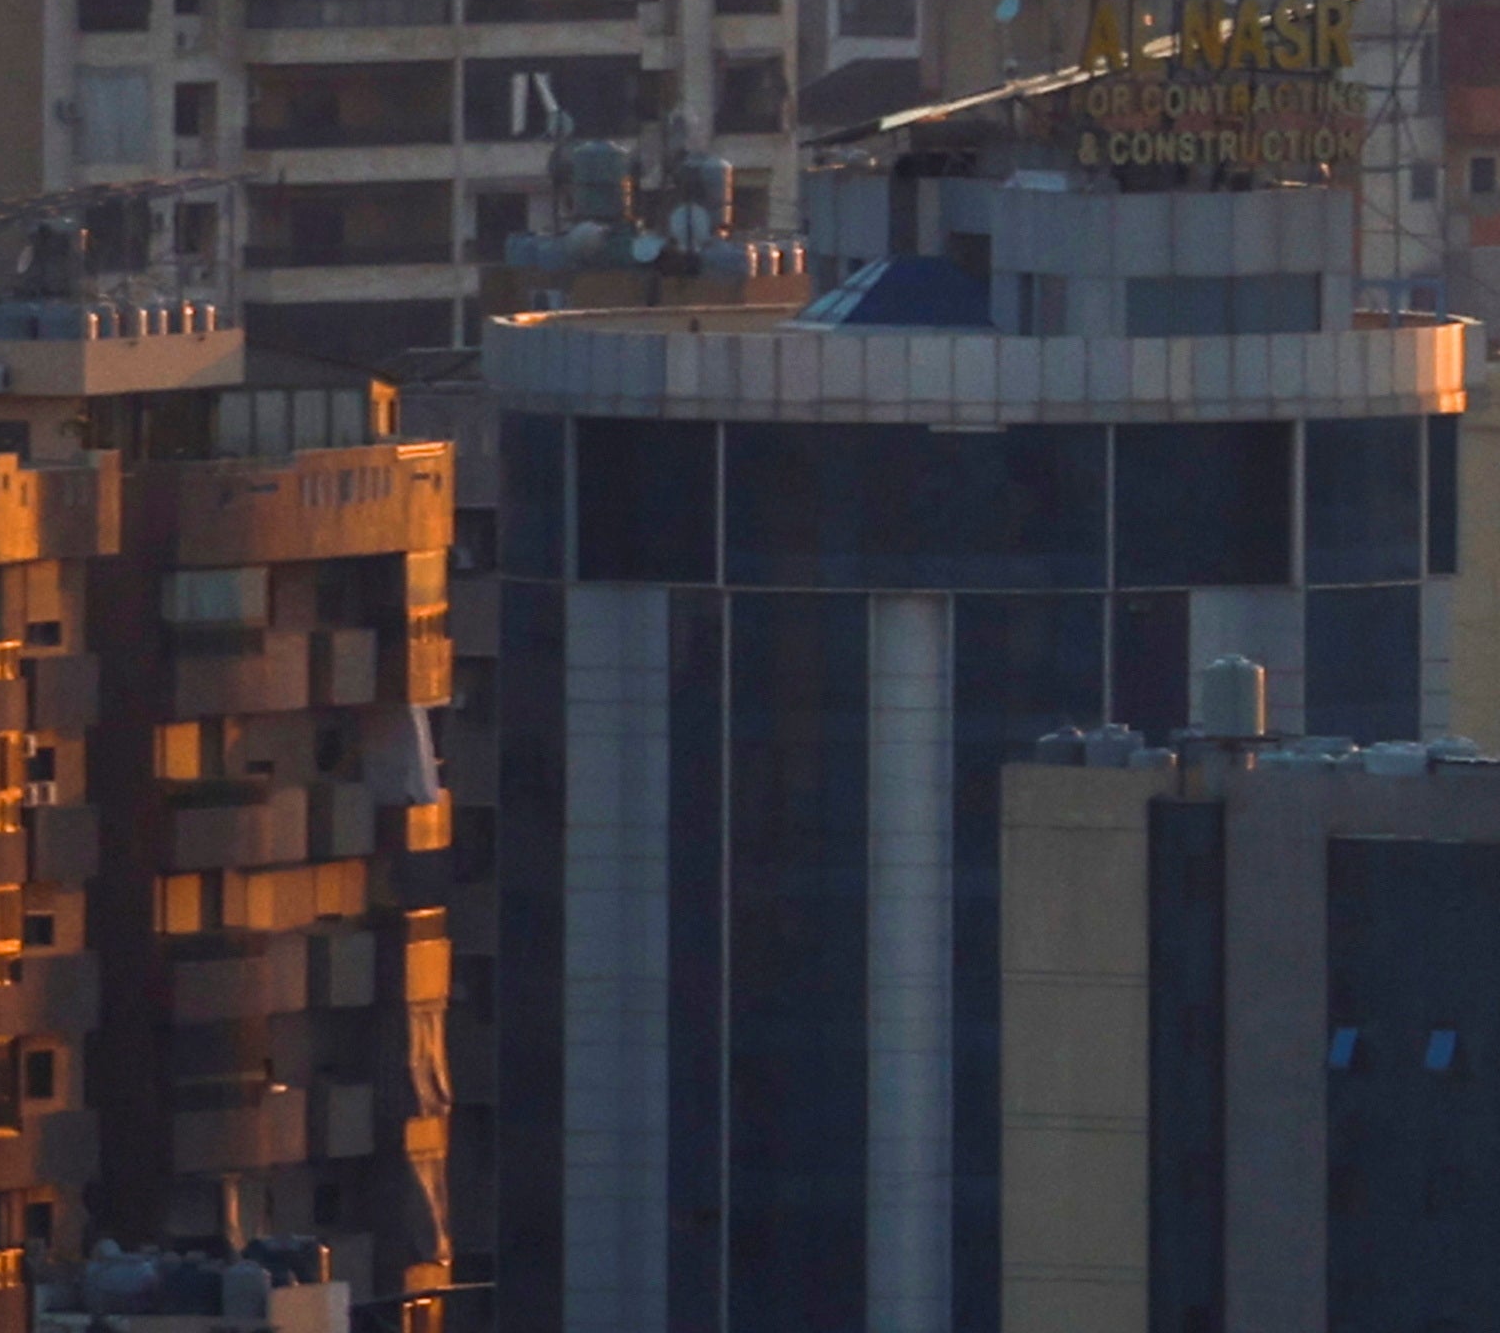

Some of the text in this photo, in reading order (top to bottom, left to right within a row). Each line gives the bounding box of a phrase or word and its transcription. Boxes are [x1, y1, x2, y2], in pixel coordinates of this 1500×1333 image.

[1141, 81, 1368, 118] CONTRACTING
[1078, 128, 1359, 165] & CONSTRUCTION
